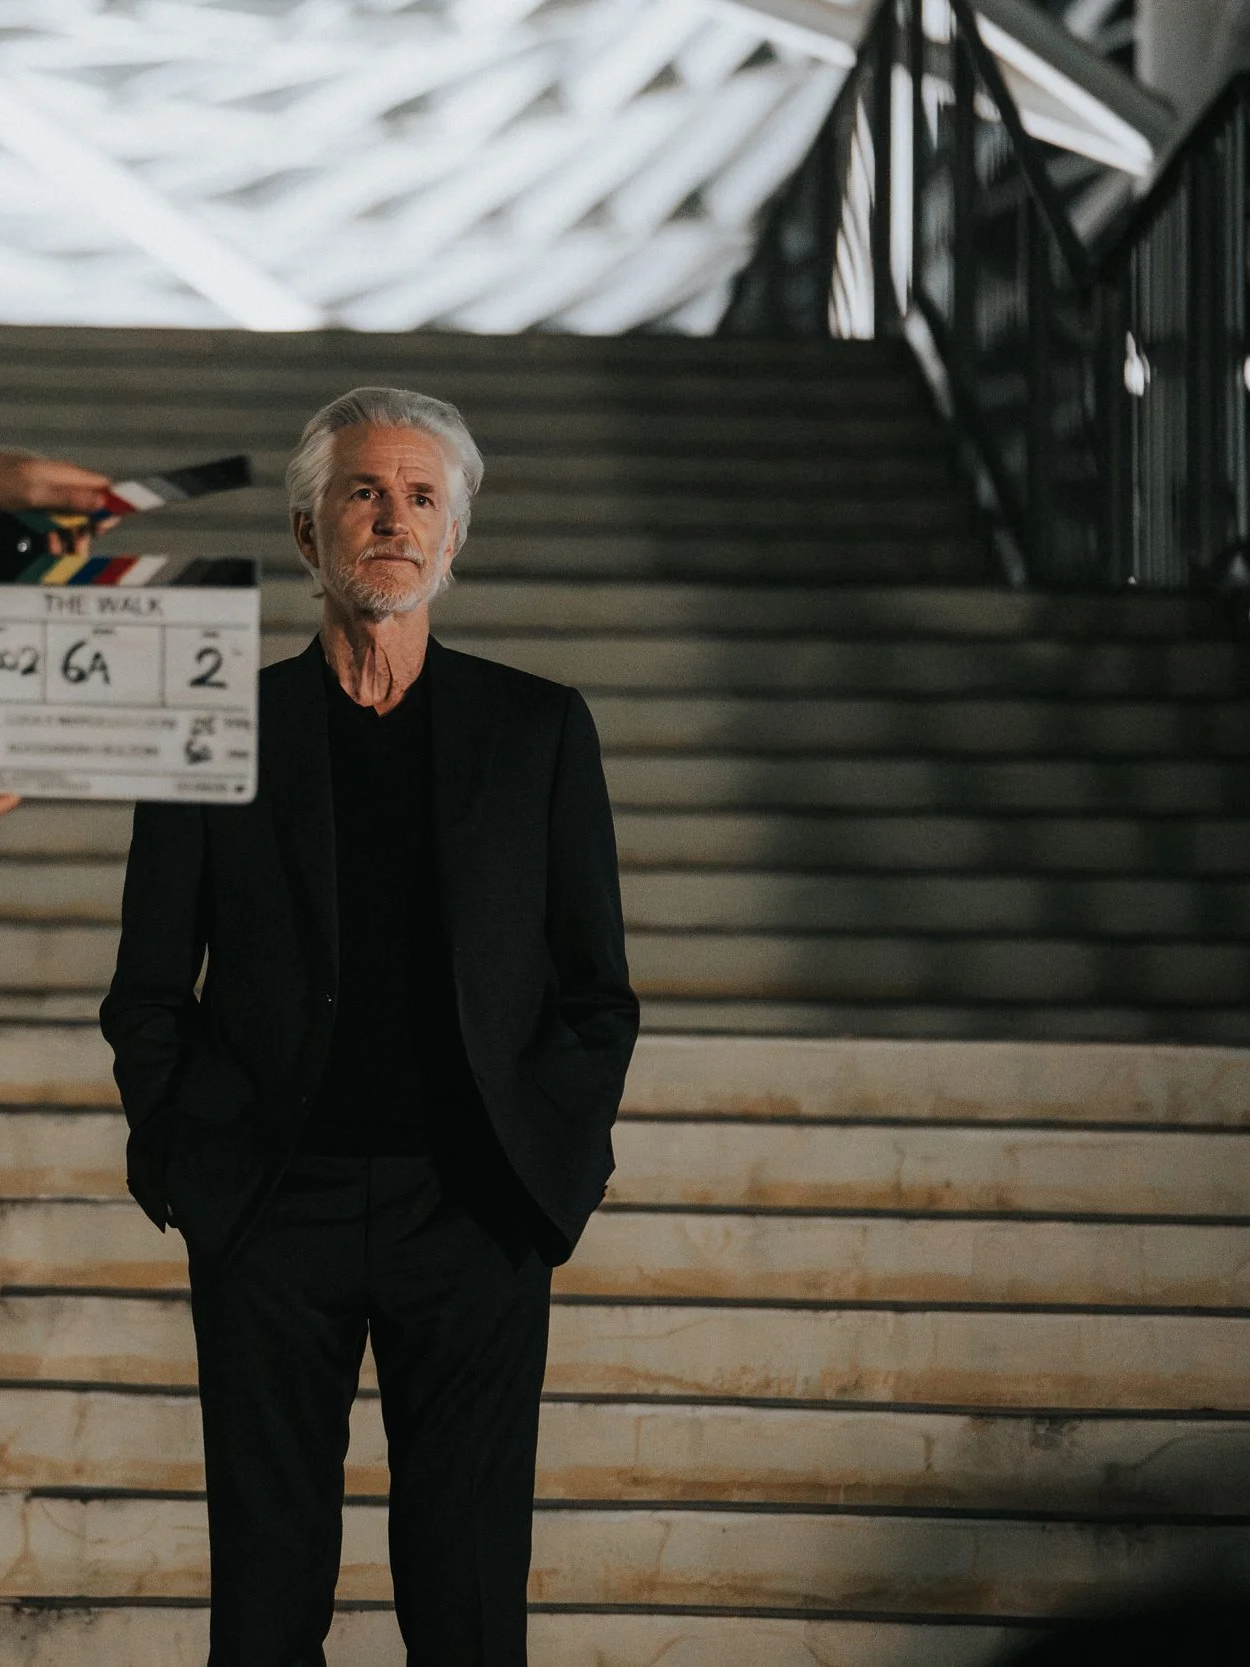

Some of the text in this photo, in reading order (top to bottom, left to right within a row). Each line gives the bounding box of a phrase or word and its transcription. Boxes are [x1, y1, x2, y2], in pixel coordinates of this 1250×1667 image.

[44, 594, 164, 616] THE WALK
[61, 638, 111, 685] 6A
[188, 647, 227, 689] 2
